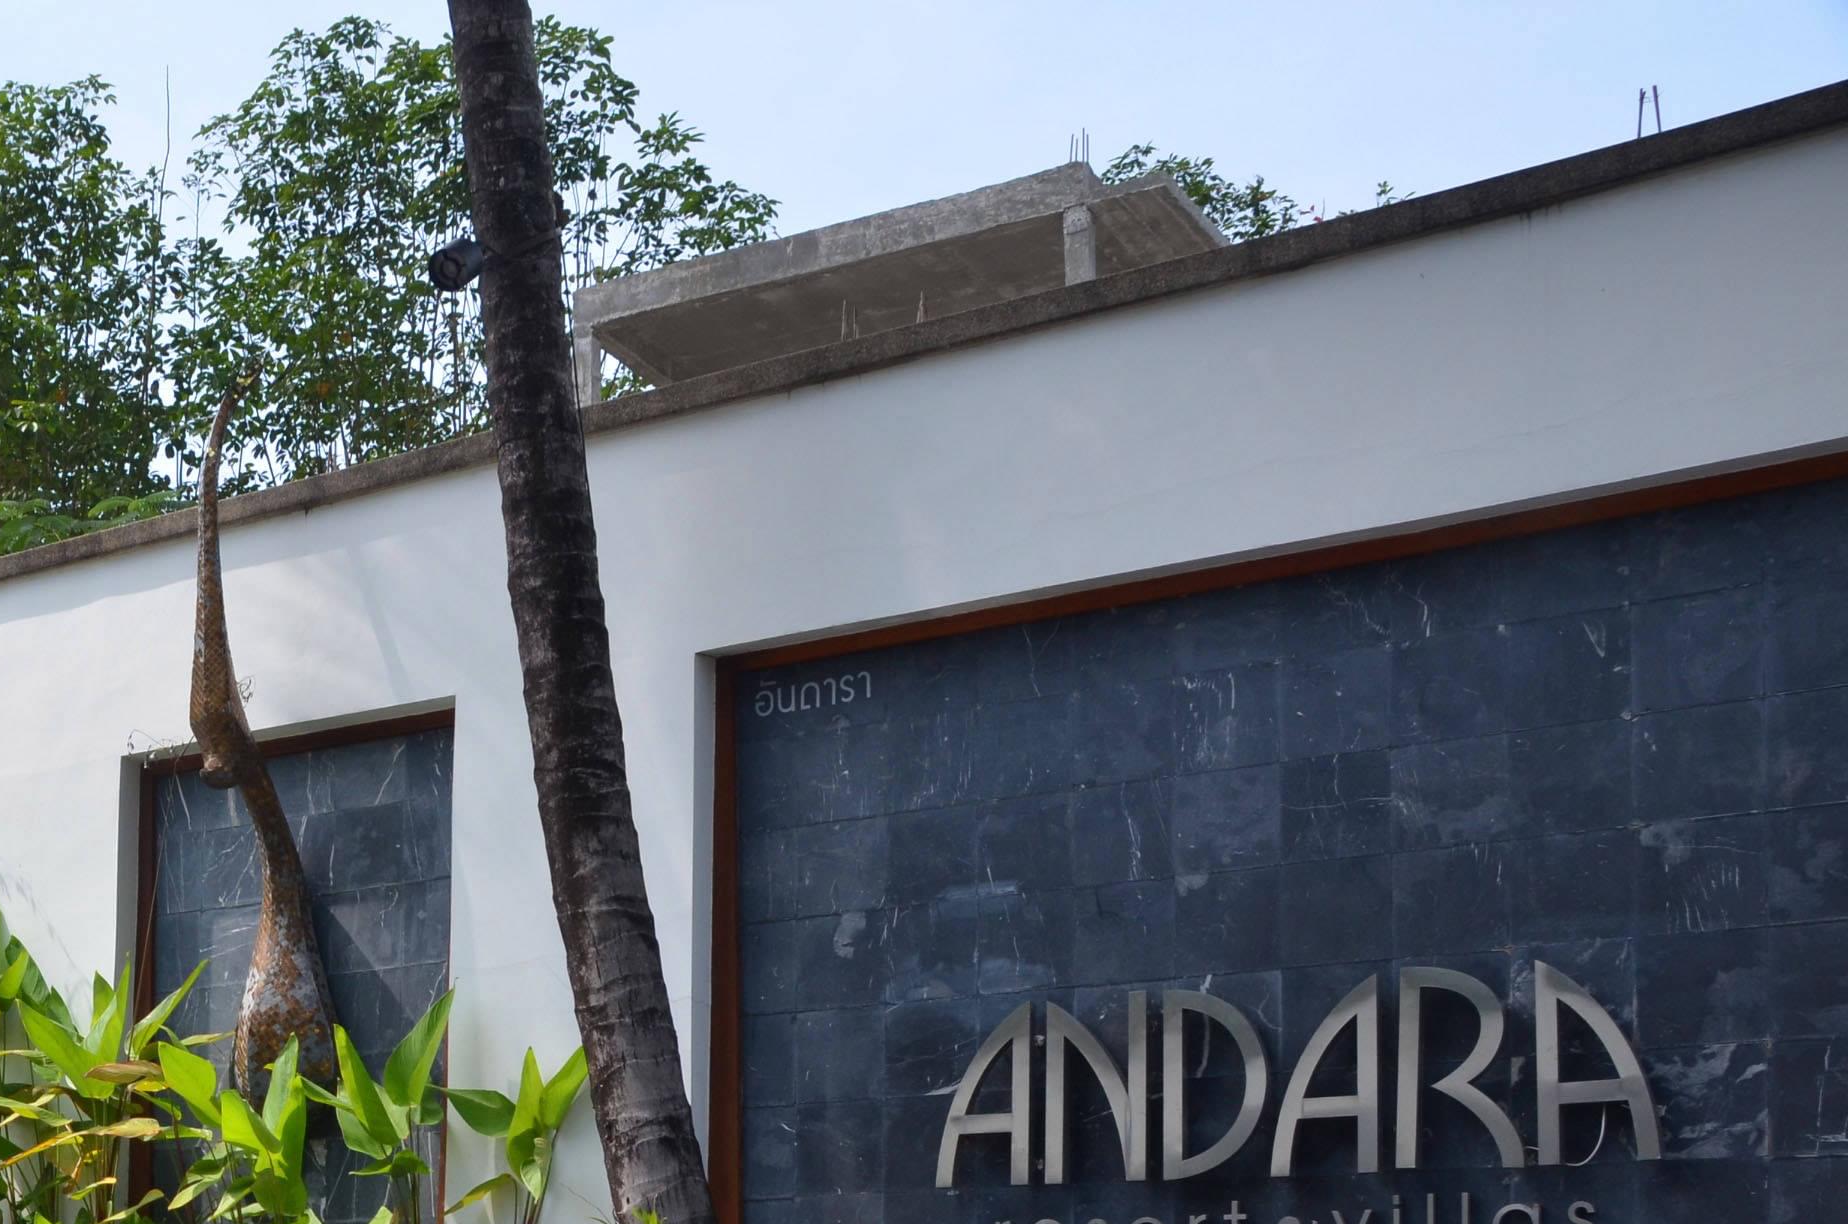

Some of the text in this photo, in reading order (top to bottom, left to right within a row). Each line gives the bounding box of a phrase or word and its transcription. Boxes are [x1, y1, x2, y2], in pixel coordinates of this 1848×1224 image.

[754, 671, 872, 717] อันดารา
[934, 959, 1662, 1188] ANDARA
